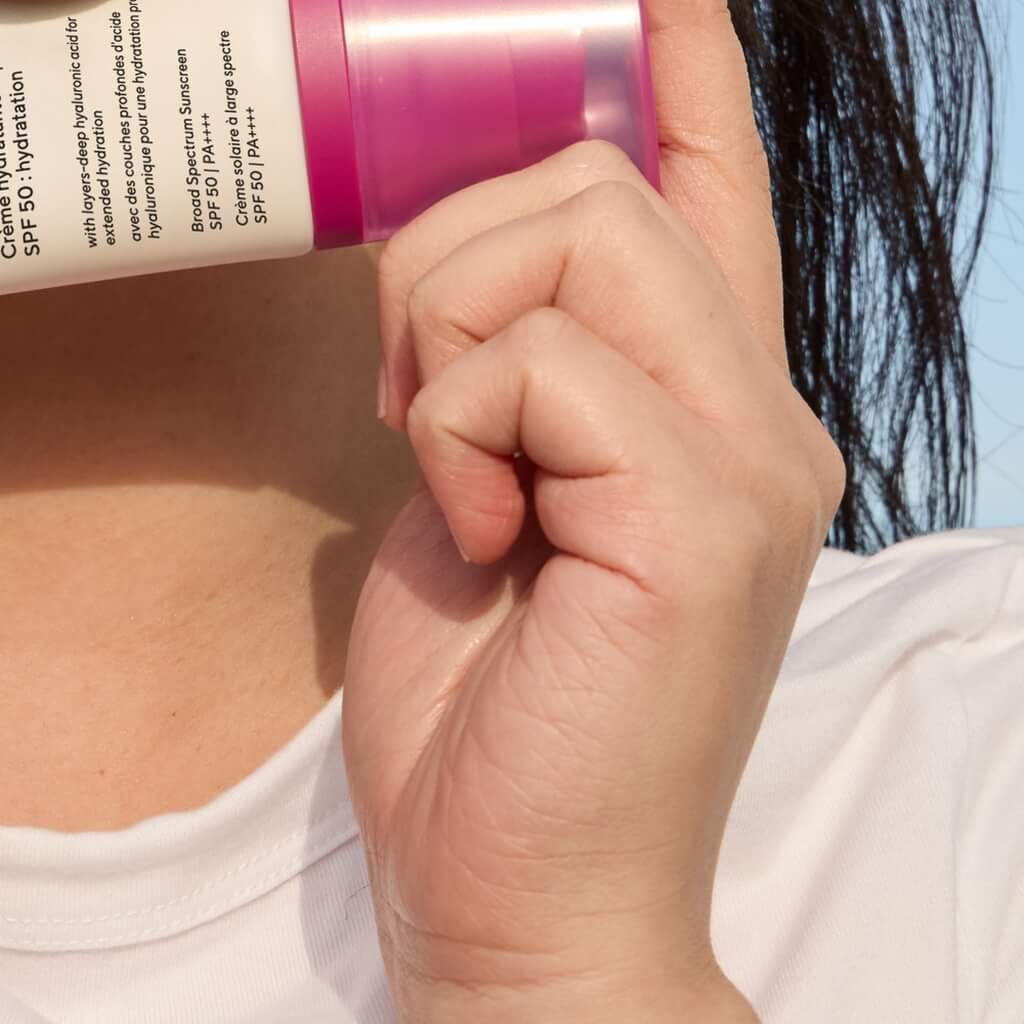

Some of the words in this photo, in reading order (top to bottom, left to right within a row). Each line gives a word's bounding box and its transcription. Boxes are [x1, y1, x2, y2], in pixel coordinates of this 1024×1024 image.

[65, 17, 78, 32] for
[109, 11, 124, 53] d'acide
[65, 35, 80, 60] acid
[128, 14, 148, 84] hydratation
[219, 30, 236, 77] spectre
[68, 62, 88, 128] hyaluronic
[113, 55, 133, 119] profondes
[136, 86, 148, 111] une
[177, 48, 192, 115] Sunscreen
[224, 79, 238, 113] large
[9, 70, 34, 172] hydratation
[92, 110, 111, 176] hydration
[138, 112, 153, 144] pour
[201, 113, 216, 164] PA++++
[225, 116, 238, 126] à
[245, 106, 260, 158] PA++++
[119, 120, 134, 177] couches
[184, 118, 202, 185] Spectrum
[228, 128, 244, 175] solaire
[76, 131, 96, 214] layers-deep
[124, 180, 138, 205] des
[141, 147, 162, 239] hyaluronique
[204, 177, 219, 197] 50
[249, 170, 264, 191] 50
[96, 179, 116, 246] extended
[129, 207, 142, 242] avec
[187, 189, 204, 232] Broad
[207, 200, 223, 230] SPF
[234, 178, 248, 226] Crème
[252, 193, 268, 224] SPF
[20, 218, 40, 256] SPF
[83, 217, 98, 248] with
